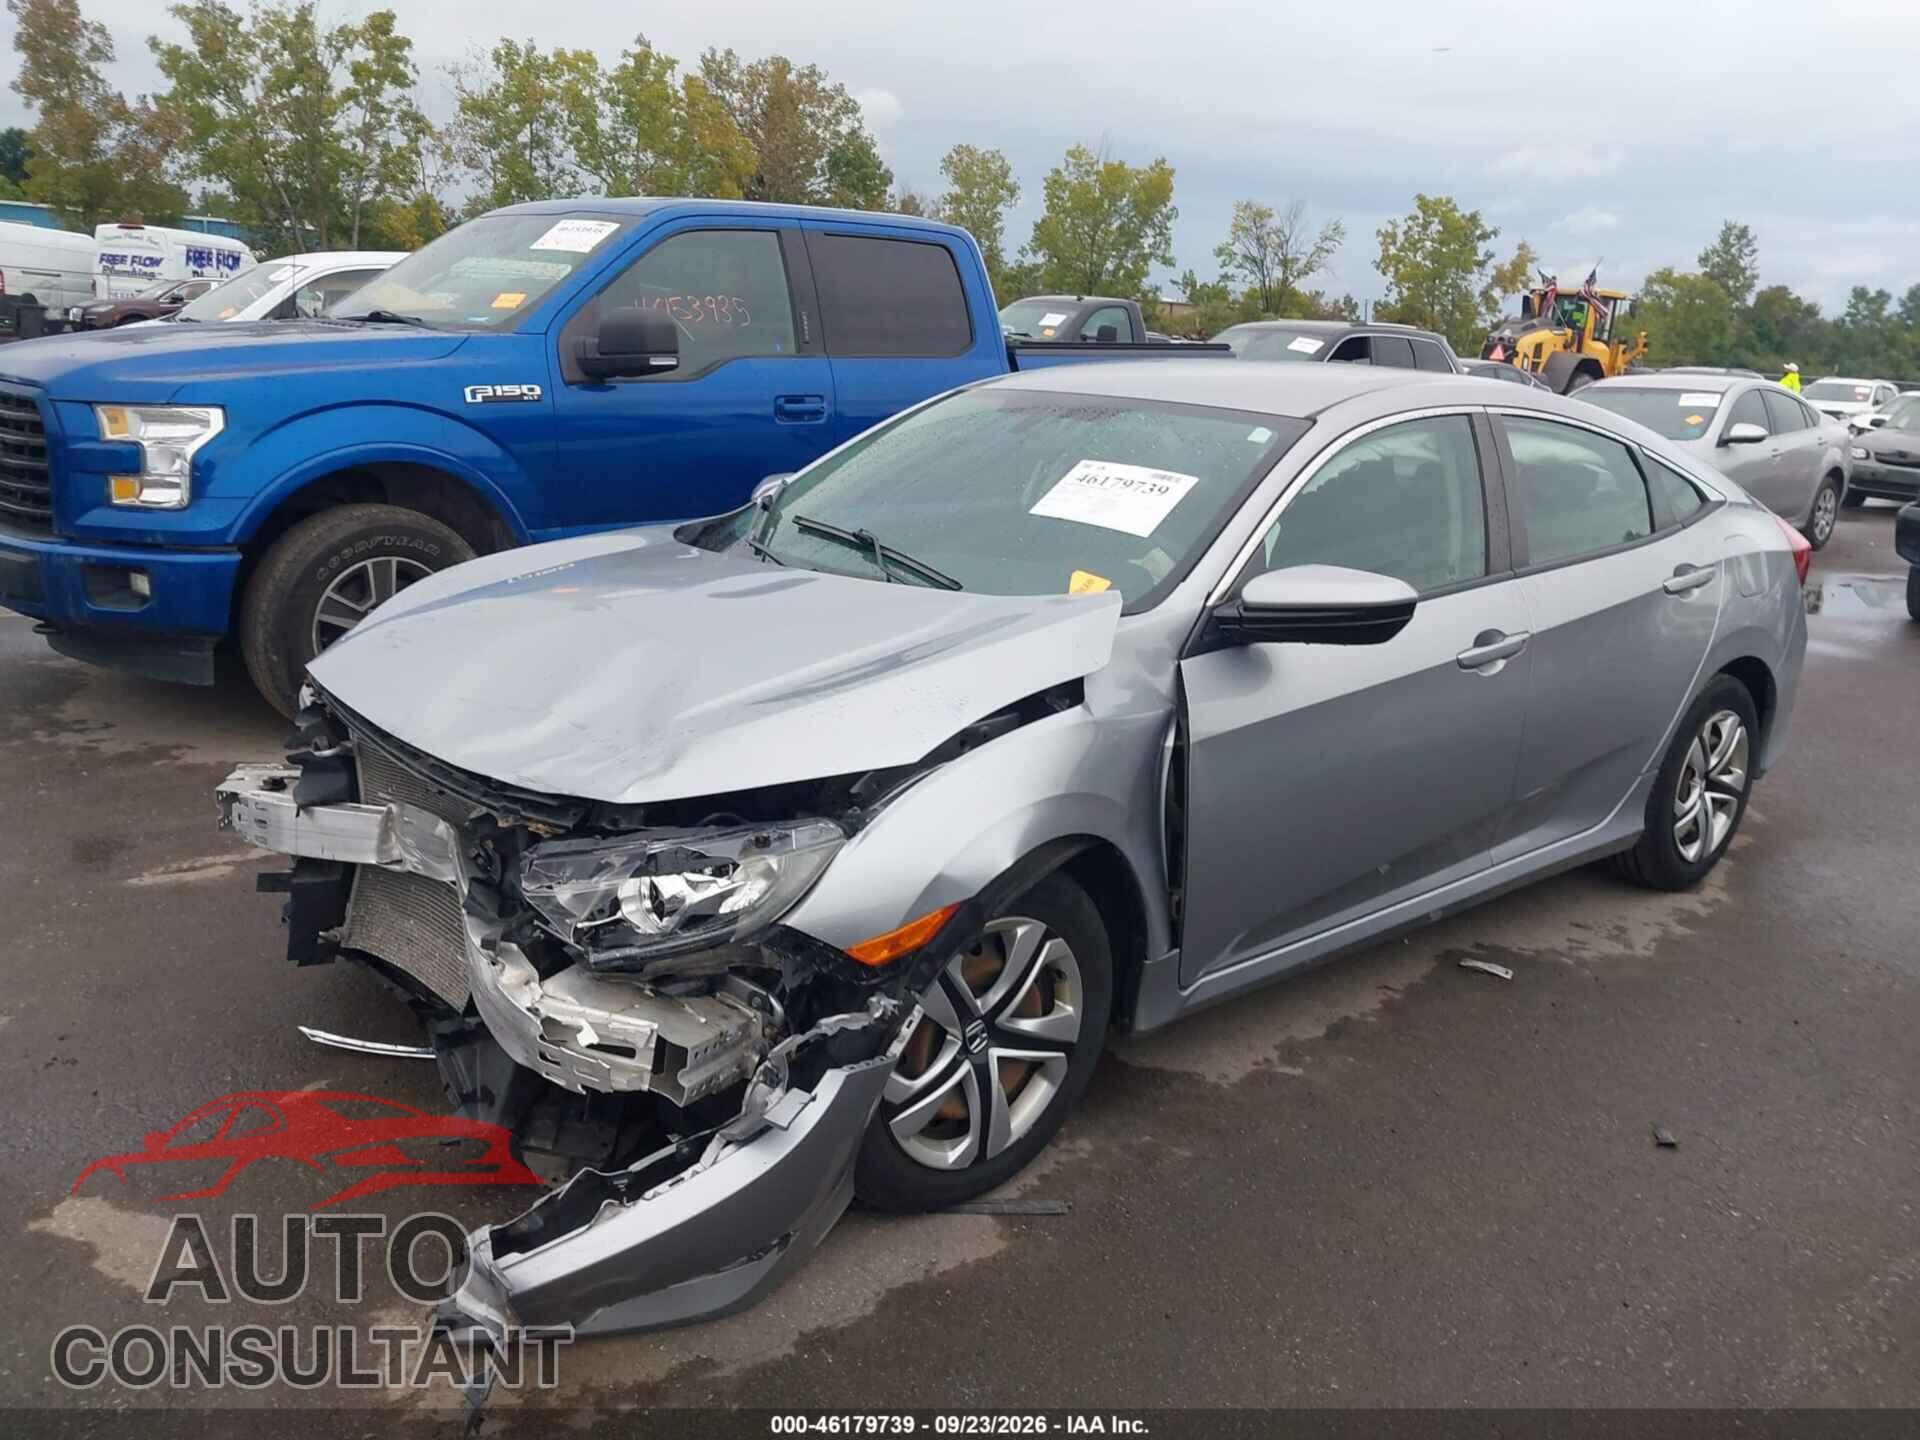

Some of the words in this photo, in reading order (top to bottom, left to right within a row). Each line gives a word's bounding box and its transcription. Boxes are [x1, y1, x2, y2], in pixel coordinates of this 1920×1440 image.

[99, 253, 128, 265] FREE
[130, 255, 164, 268] FLOW
[186, 248, 213, 268] FREE
[216, 250, 241, 271] FLOW
[1075, 473, 1171, 496] 46179739
